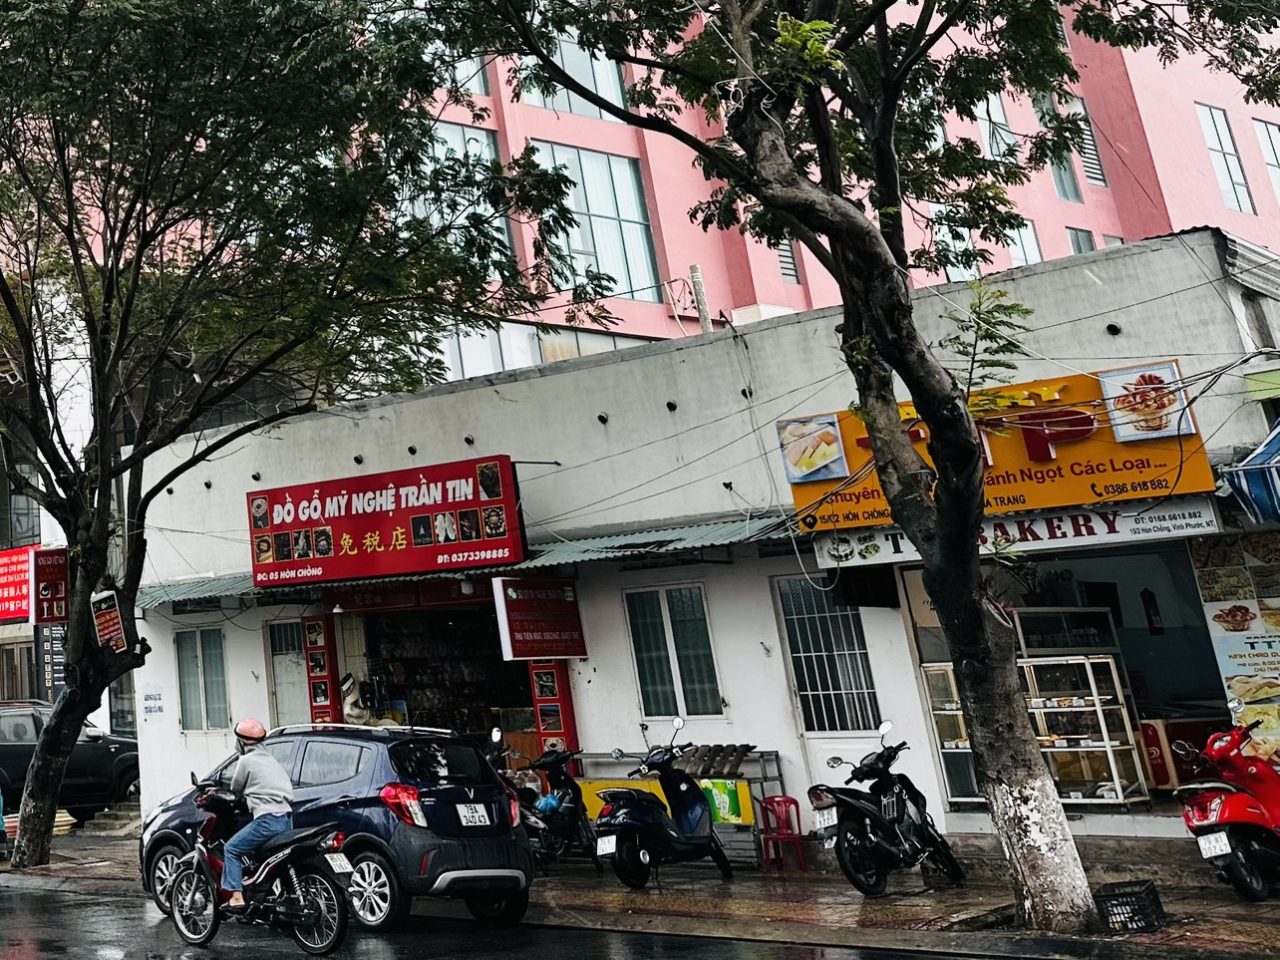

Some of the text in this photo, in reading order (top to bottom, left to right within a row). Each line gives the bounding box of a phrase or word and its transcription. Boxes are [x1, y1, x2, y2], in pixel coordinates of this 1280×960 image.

[981, 469, 1018, 487] ánh
[1019, 464, 1065, 484] Ngọt
[1070, 458, 1107, 477] Các
[273, 473, 474, 525] ĐỒ GỖ MỸ NGHỆ TRẦN TIN
[993, 494, 1026, 508] TRANG
[338, 525, 408, 556] 免税店
[269, 571, 280, 580] 05
